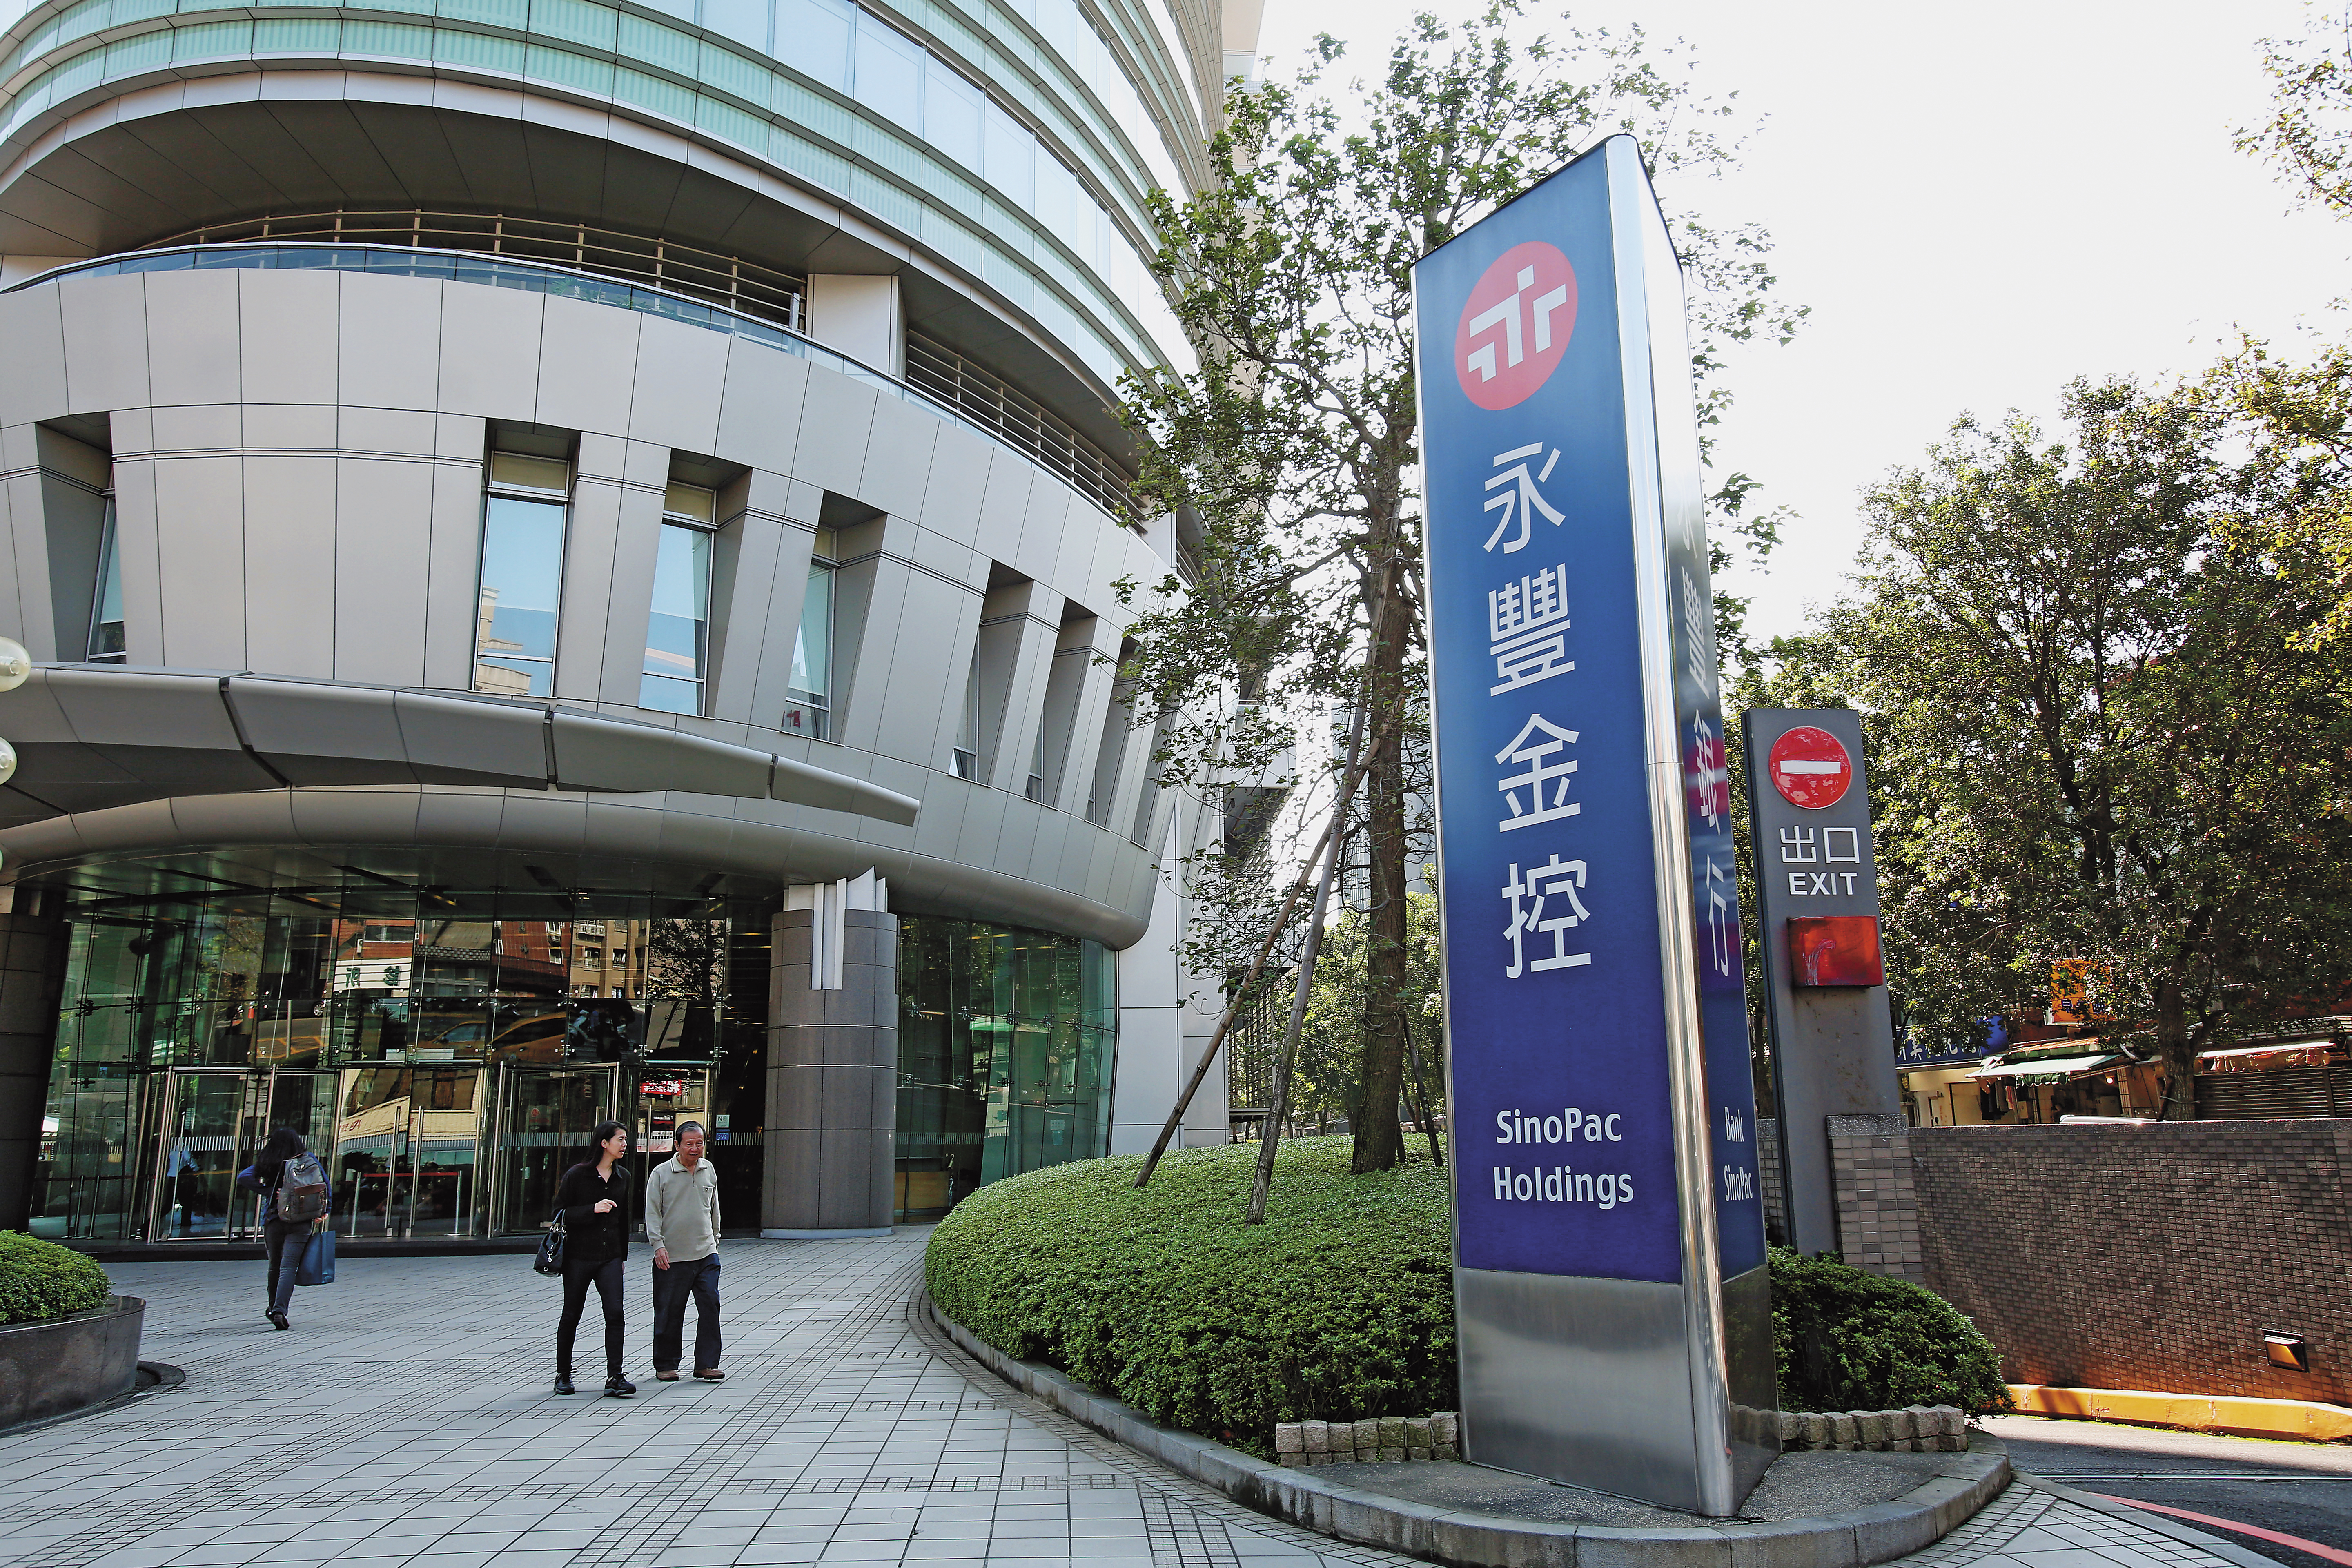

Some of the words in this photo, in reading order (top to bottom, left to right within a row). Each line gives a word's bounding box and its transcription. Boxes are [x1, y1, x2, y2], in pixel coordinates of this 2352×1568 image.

[1483, 441, 1592, 979] 永豐金控
[1780, 825, 1860, 864] 出口
[1788, 872, 1858, 895] EXIT
[1496, 1107, 1622, 1144] SinoPac
[1724, 1106, 1744, 1142] Bank
[1493, 1165, 1634, 1210] Holdings
[1724, 1164, 1753, 1201] SinoPac
